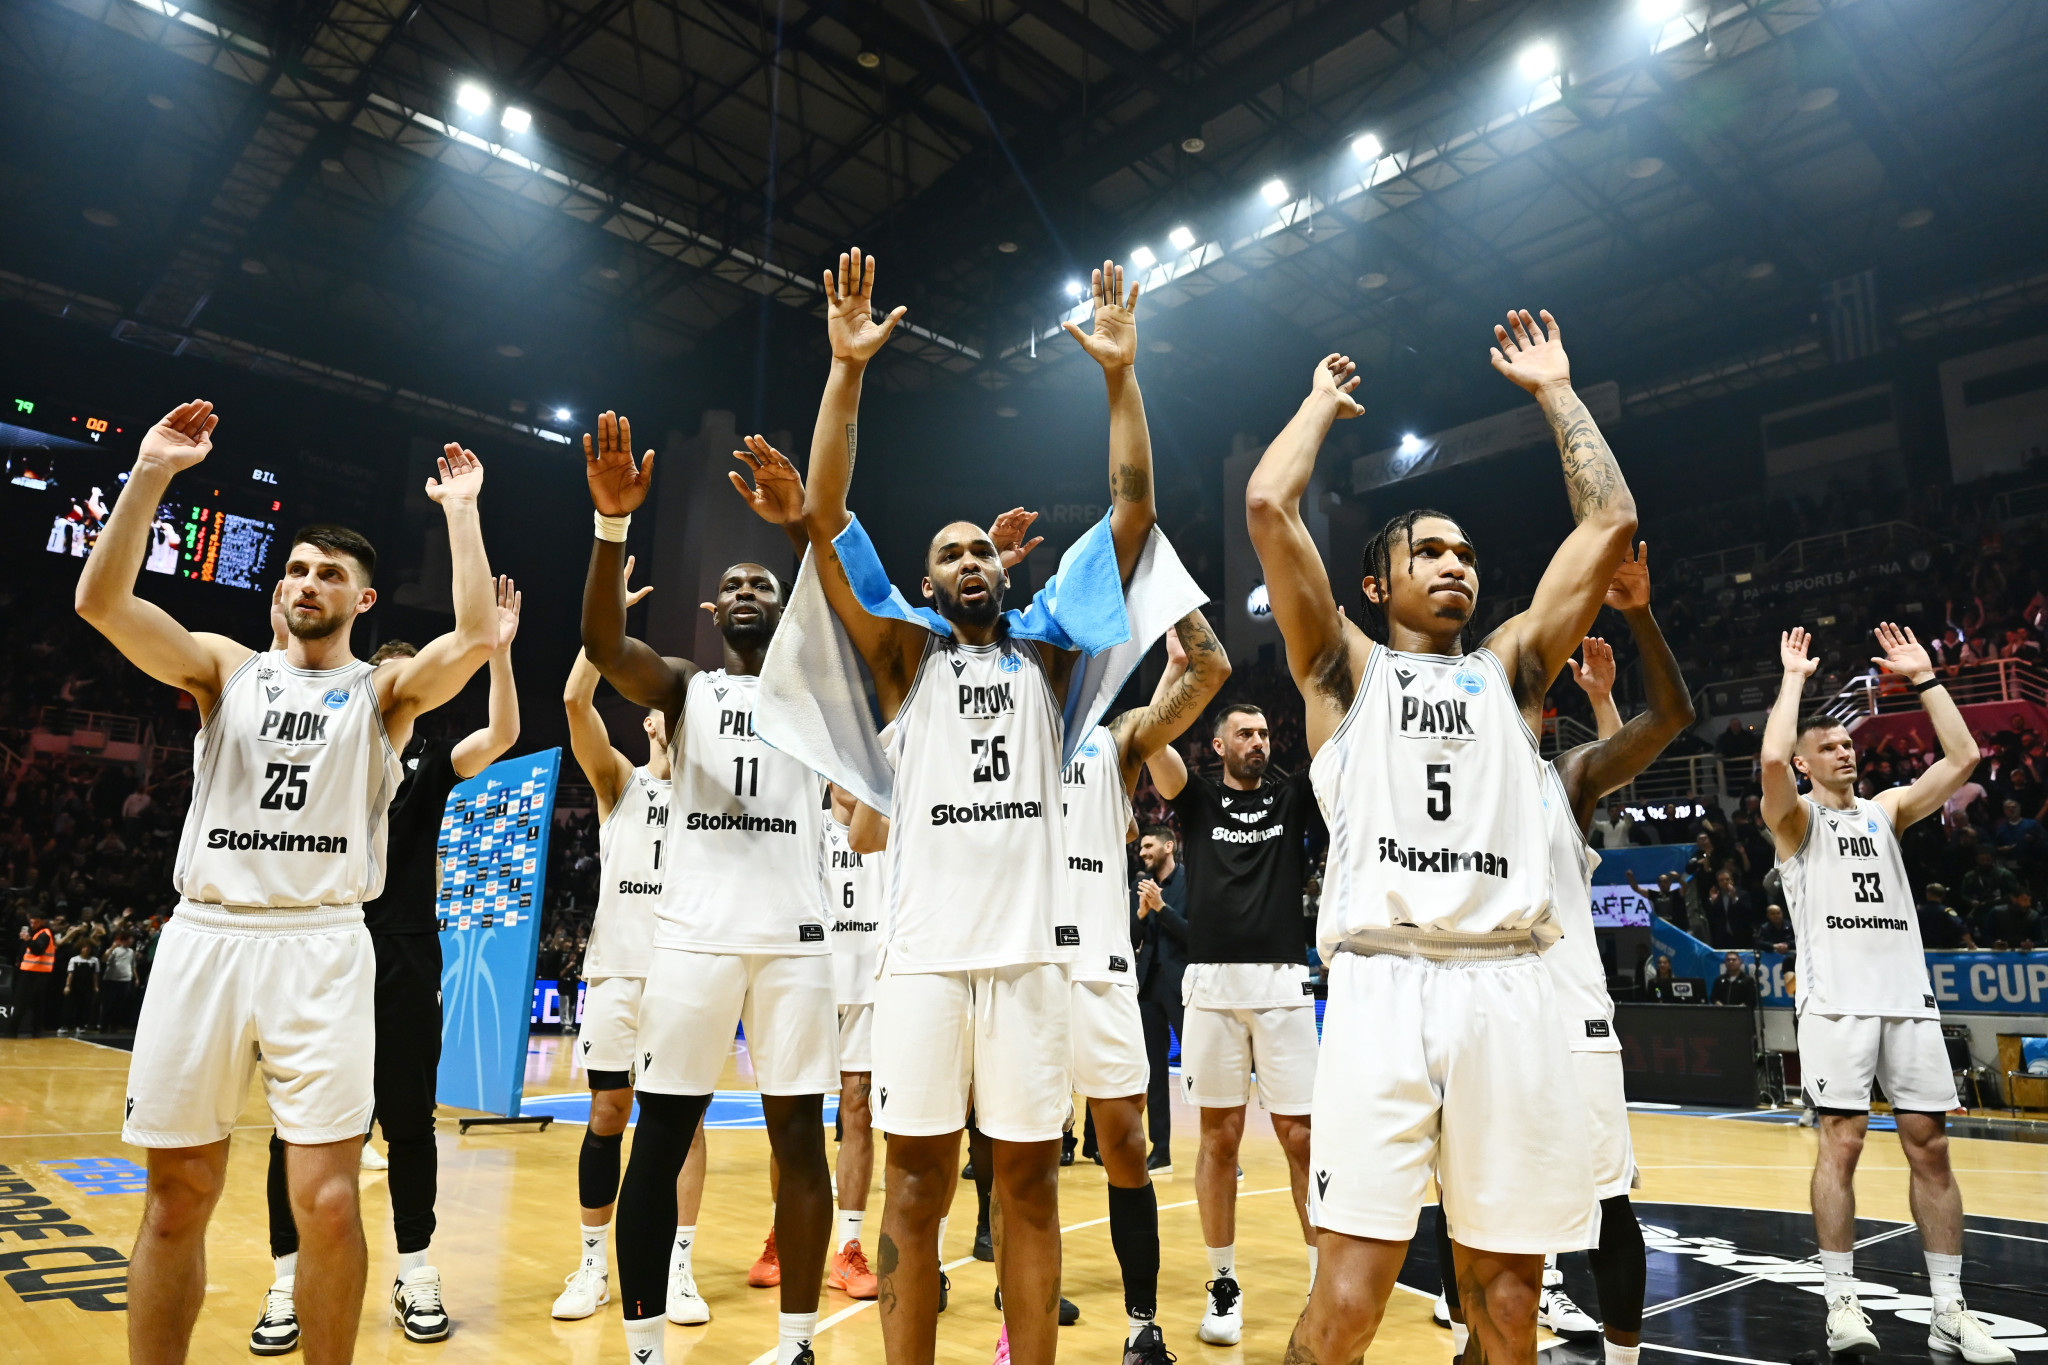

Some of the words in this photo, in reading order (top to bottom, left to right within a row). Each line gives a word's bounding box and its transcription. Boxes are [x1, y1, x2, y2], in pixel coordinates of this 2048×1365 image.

[15, 399, 34, 414] 79
[90, 432, 100, 442] 4
[252, 469, 278, 485] BIL
[1742, 582, 1781, 601] PA
[1784, 571, 1844, 594] SPORTS
[959, 682, 1014, 714] PAOK
[258, 710, 329, 741] PAOK
[1401, 695, 1475, 734] PAOK
[971, 735, 1010, 782] 26
[260, 763, 310, 811] 25
[732, 757, 758, 796] 11
[1427, 764, 1452, 821] 5
[687, 812, 797, 834] Stoiximan
[1212, 824, 1284, 843] Stoiximan
[207, 829, 347, 853] Stoiximan
[832, 851, 863, 868] PAOK
[843, 882, 854, 908] 6
[1852, 872, 1884, 903] 33
[1826, 916, 1908, 931] Stoiximan
[1970, 963, 2048, 1003] CUP
